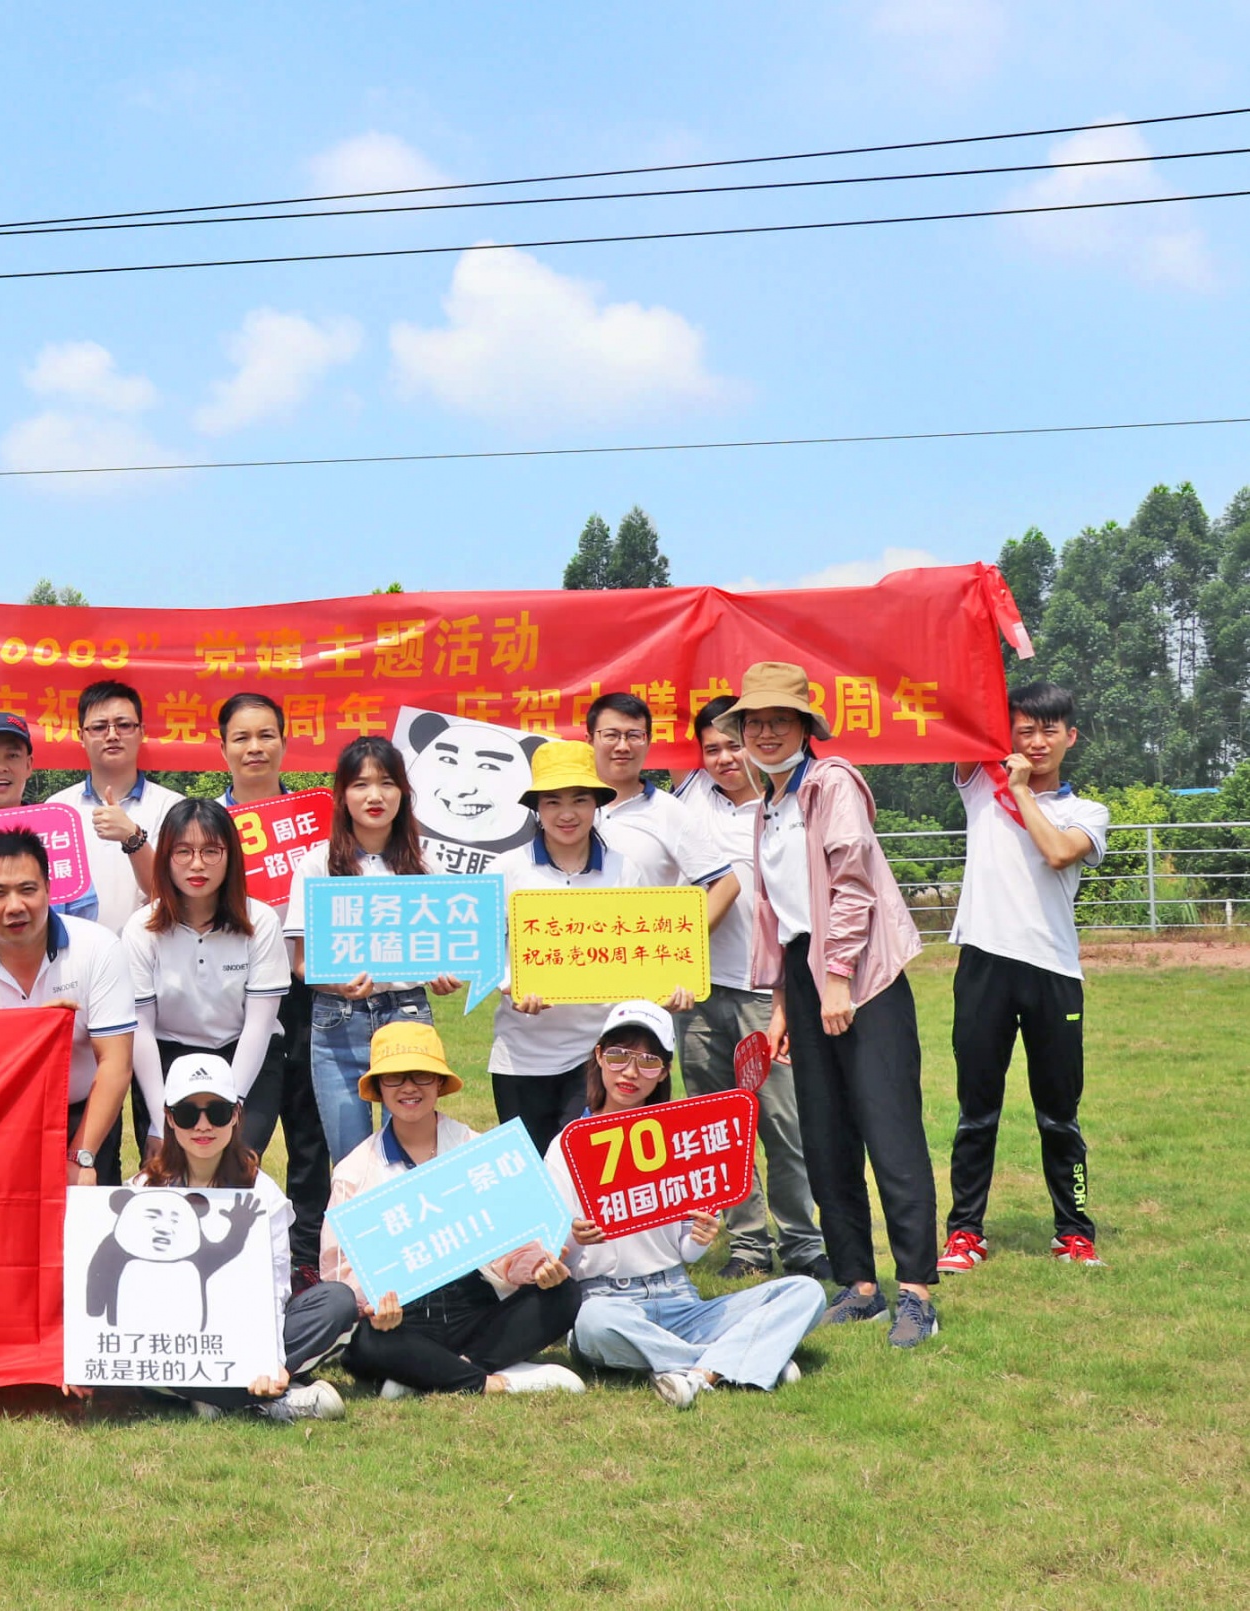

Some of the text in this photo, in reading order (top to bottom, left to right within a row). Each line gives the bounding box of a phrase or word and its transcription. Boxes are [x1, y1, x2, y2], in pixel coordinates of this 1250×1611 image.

[234, 811, 319, 855] 3周年
[331, 893, 479, 927] 服务大众
[522, 915, 694, 937] 不忘初心永立潮头
[331, 930, 479, 965] 死磕自己
[522, 945, 694, 967] 祝福党98周年华诞
[589, 1117, 743, 1185] 70华诞!
[355, 1149, 527, 1239] 一群人一条心
[597, 1162, 731, 1225] 祖国你好!
[373, 1208, 496, 1276] 一起拼!!!
[97, 1332, 224, 1355] 拍了我的照
[84, 1358, 237, 1382] 就是我的人了
